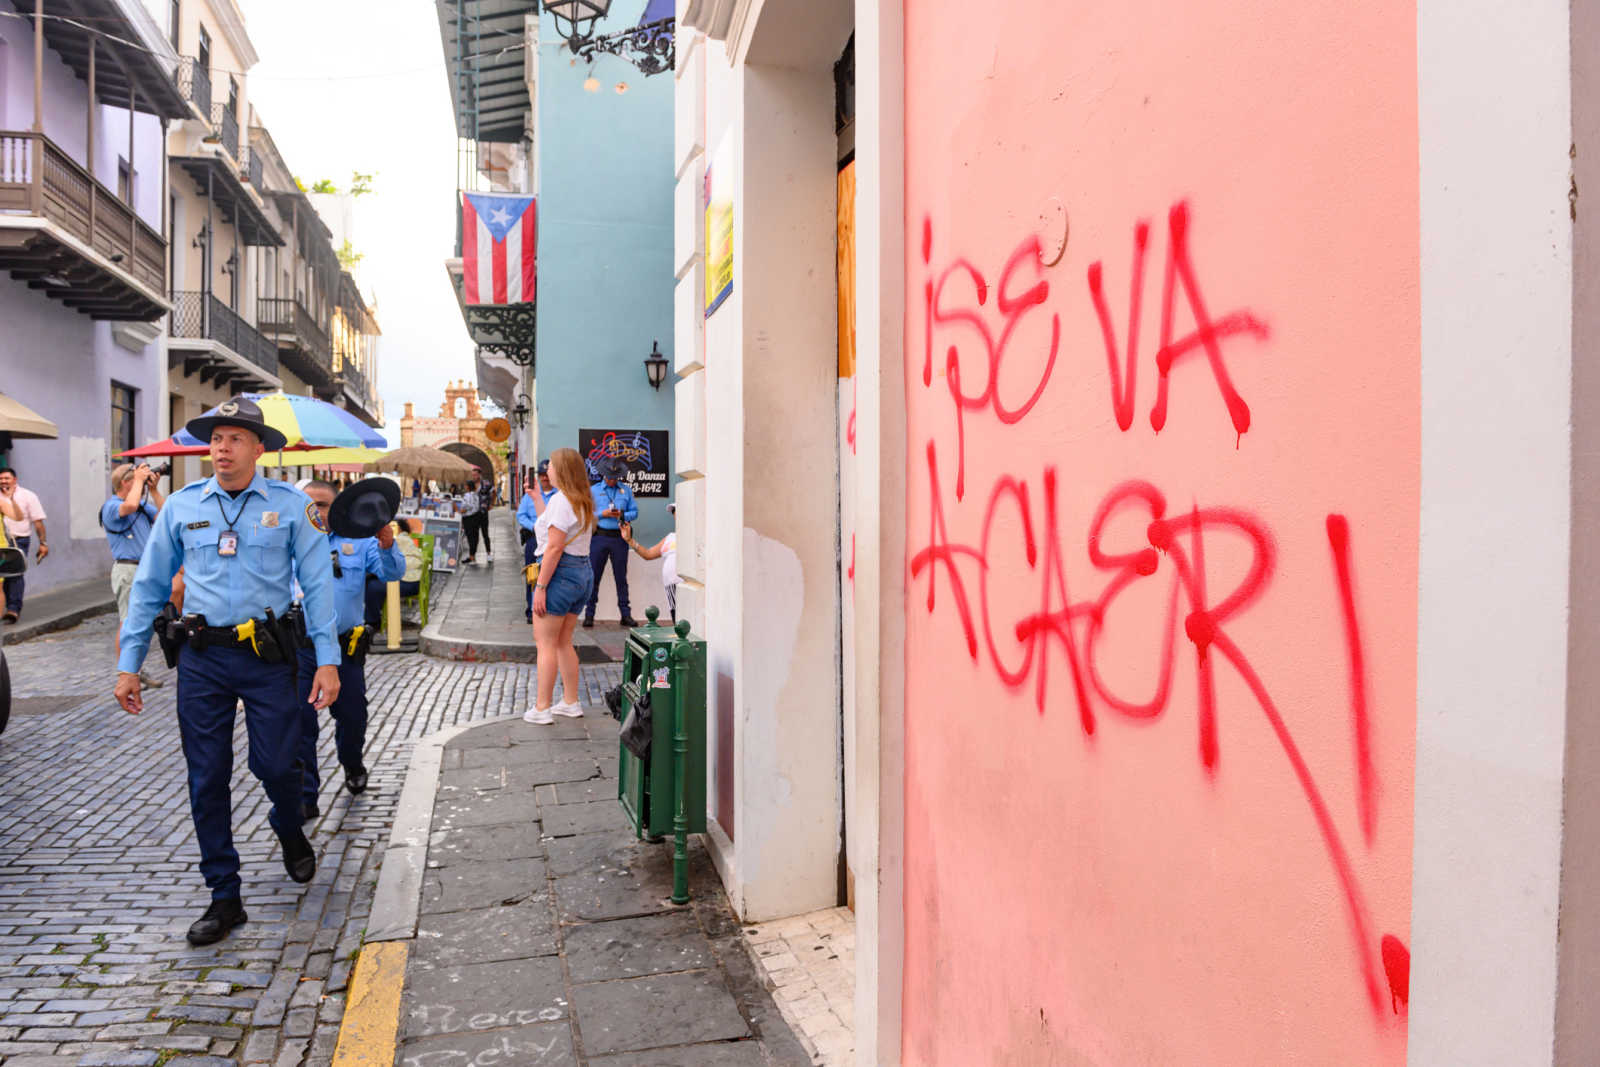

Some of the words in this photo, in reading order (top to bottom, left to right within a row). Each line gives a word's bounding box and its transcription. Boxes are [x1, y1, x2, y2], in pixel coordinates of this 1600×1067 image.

[1087, 199, 1273, 450] VA
[626, 470, 636, 483] La
[637, 470, 666, 481] Danza
[623, 481, 662, 493] 3-1642
